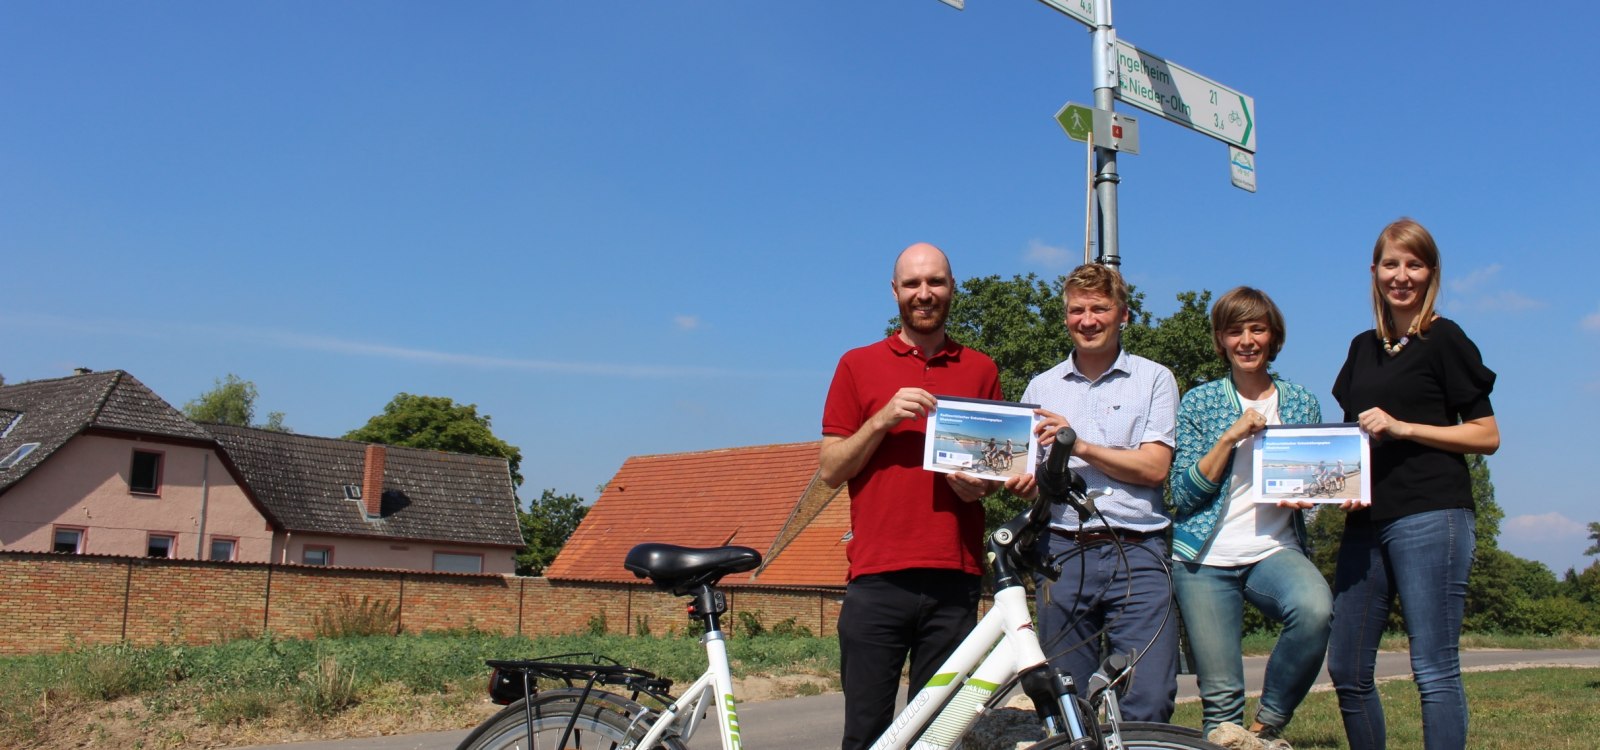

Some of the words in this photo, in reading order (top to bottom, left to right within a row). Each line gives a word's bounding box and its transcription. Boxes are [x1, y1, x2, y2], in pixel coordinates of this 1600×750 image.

[1116, 48, 1170, 85] Ingelheim
[1209, 89, 1218, 106] 21
[1129, 77, 1191, 117] Nieder-Olm
